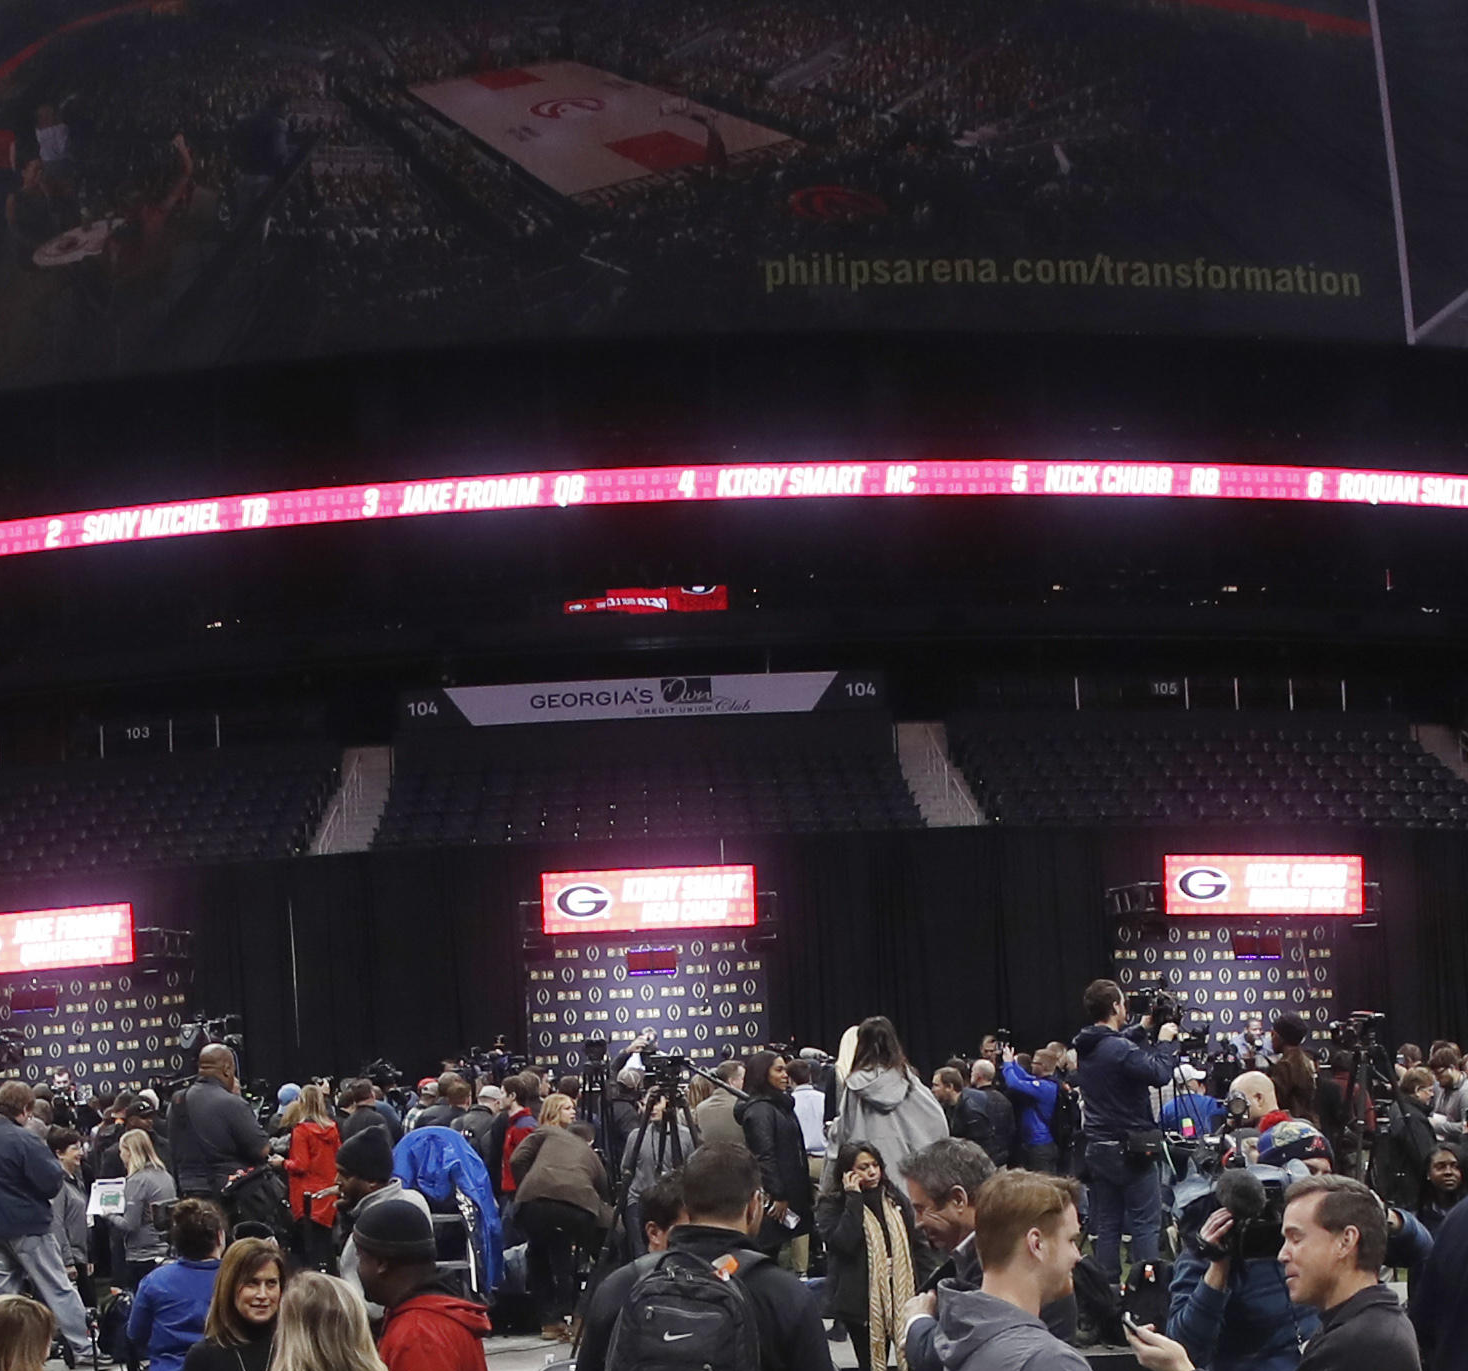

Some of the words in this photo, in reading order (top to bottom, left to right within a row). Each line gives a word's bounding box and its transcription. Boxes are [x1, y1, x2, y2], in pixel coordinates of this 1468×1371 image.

[763, 251, 1363, 298] philipsarena.com/transformation
[45, 519, 62, 548] 2
[82, 510, 139, 545] SONY
[139, 500, 221, 538] MICHEL
[239, 497, 269, 527] TB
[361, 489, 379, 518] 3
[399, 481, 453, 514] JAKE
[453, 476, 542, 509] FROMM
[552, 475, 585, 507] QB
[678, 470, 695, 498] 4
[716, 467, 785, 498] KIRBY
[787, 465, 866, 497] SMART
[884, 465, 918, 494] HC
[1011, 464, 1028, 492] 5
[1044, 465, 1098, 494] NICK
[1100, 465, 1174, 495] CHUBB
[1189, 467, 1221, 496] RB
[1307, 471, 1324, 498] 6
[1337, 473, 1420, 506] ROQUAN
[529, 685, 654, 710] GEORGIA'S
[661, 676, 712, 703] Own
[844, 681, 877, 697] 104
[1153, 682, 1178, 696] 105
[407, 701, 439, 717] 104
[636, 706, 676, 716] CREDIT
[679, 704, 713, 714] UNION
[714, 695, 752, 713] Club
[126, 726, 150, 740] 103
